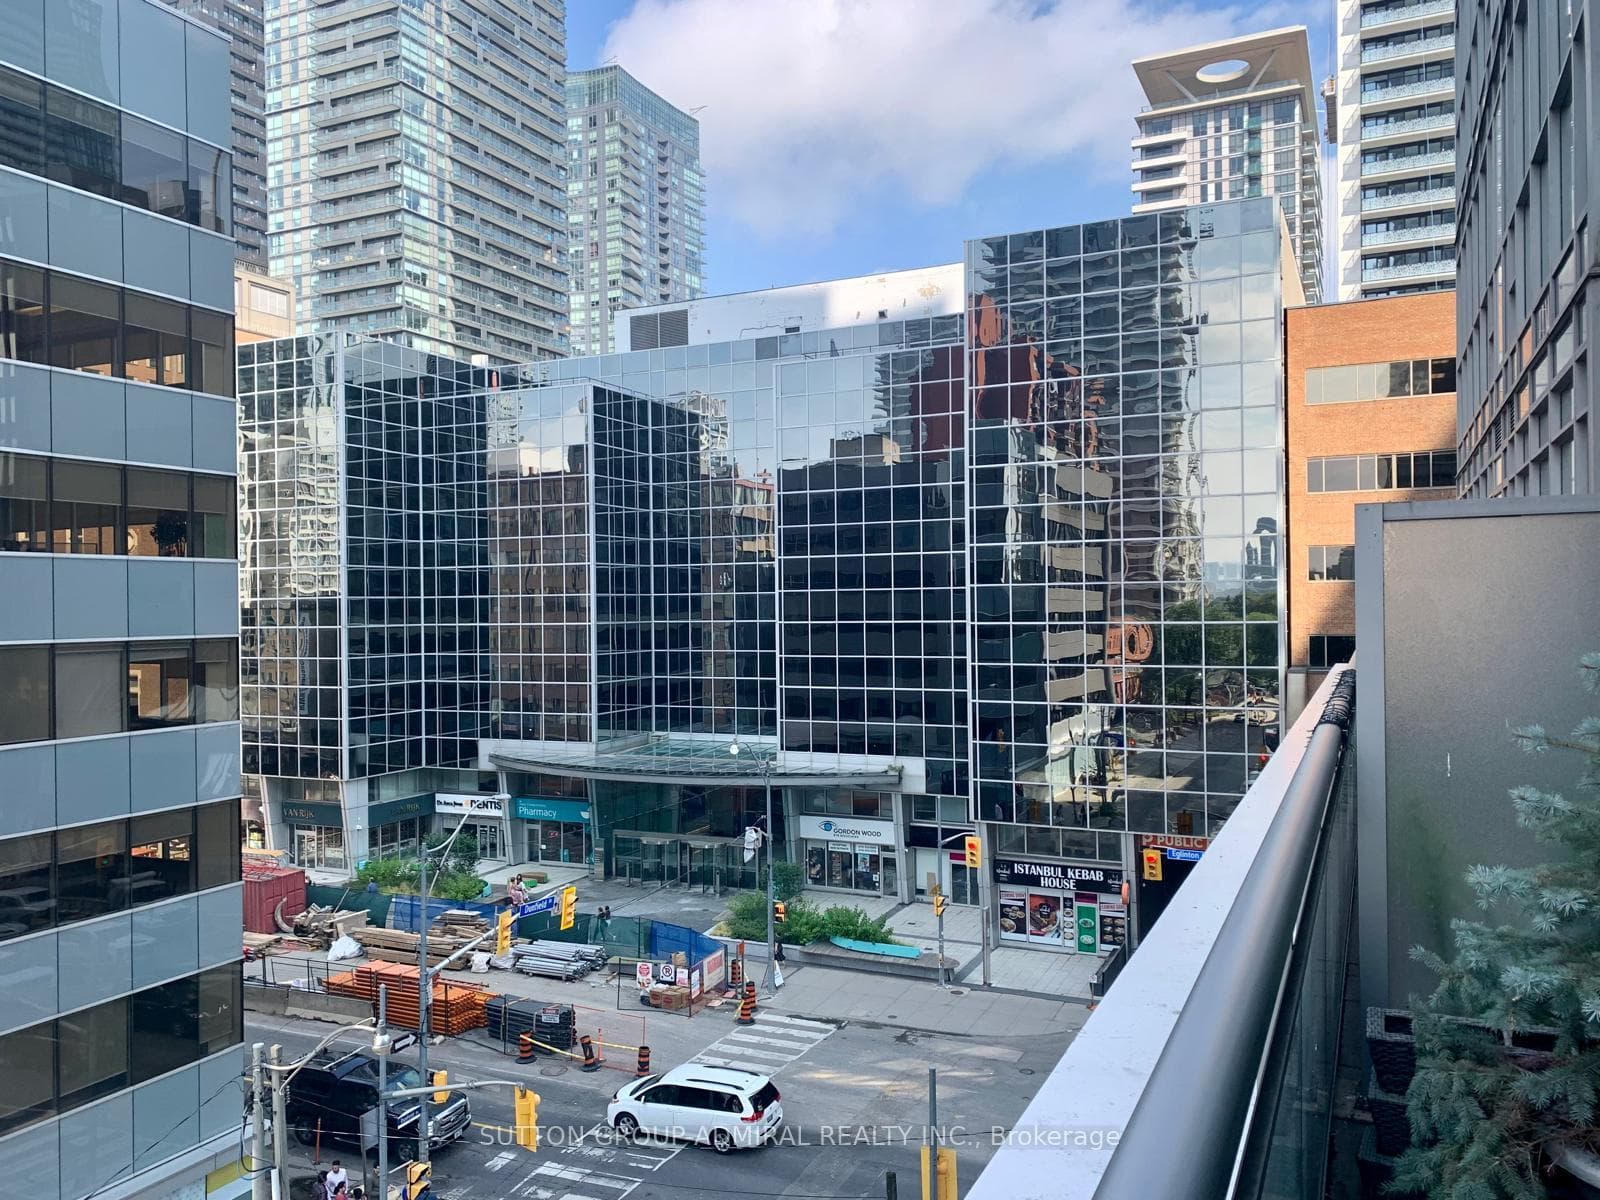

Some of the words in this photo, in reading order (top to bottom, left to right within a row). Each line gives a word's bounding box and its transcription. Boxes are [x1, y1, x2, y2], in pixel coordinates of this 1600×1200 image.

[470, 799, 502, 810] DENTIS
[518, 806, 557, 819] Pharmacy
[1156, 836, 1204, 848] PUBLIC
[1171, 850, 1200, 860] Eglinton
[1013, 863, 1065, 878] ISTANBUL
[1067, 867, 1104, 882] KEBAB
[1040, 877, 1077, 890] HOUSE
[524, 899, 548, 914] Dunfield
